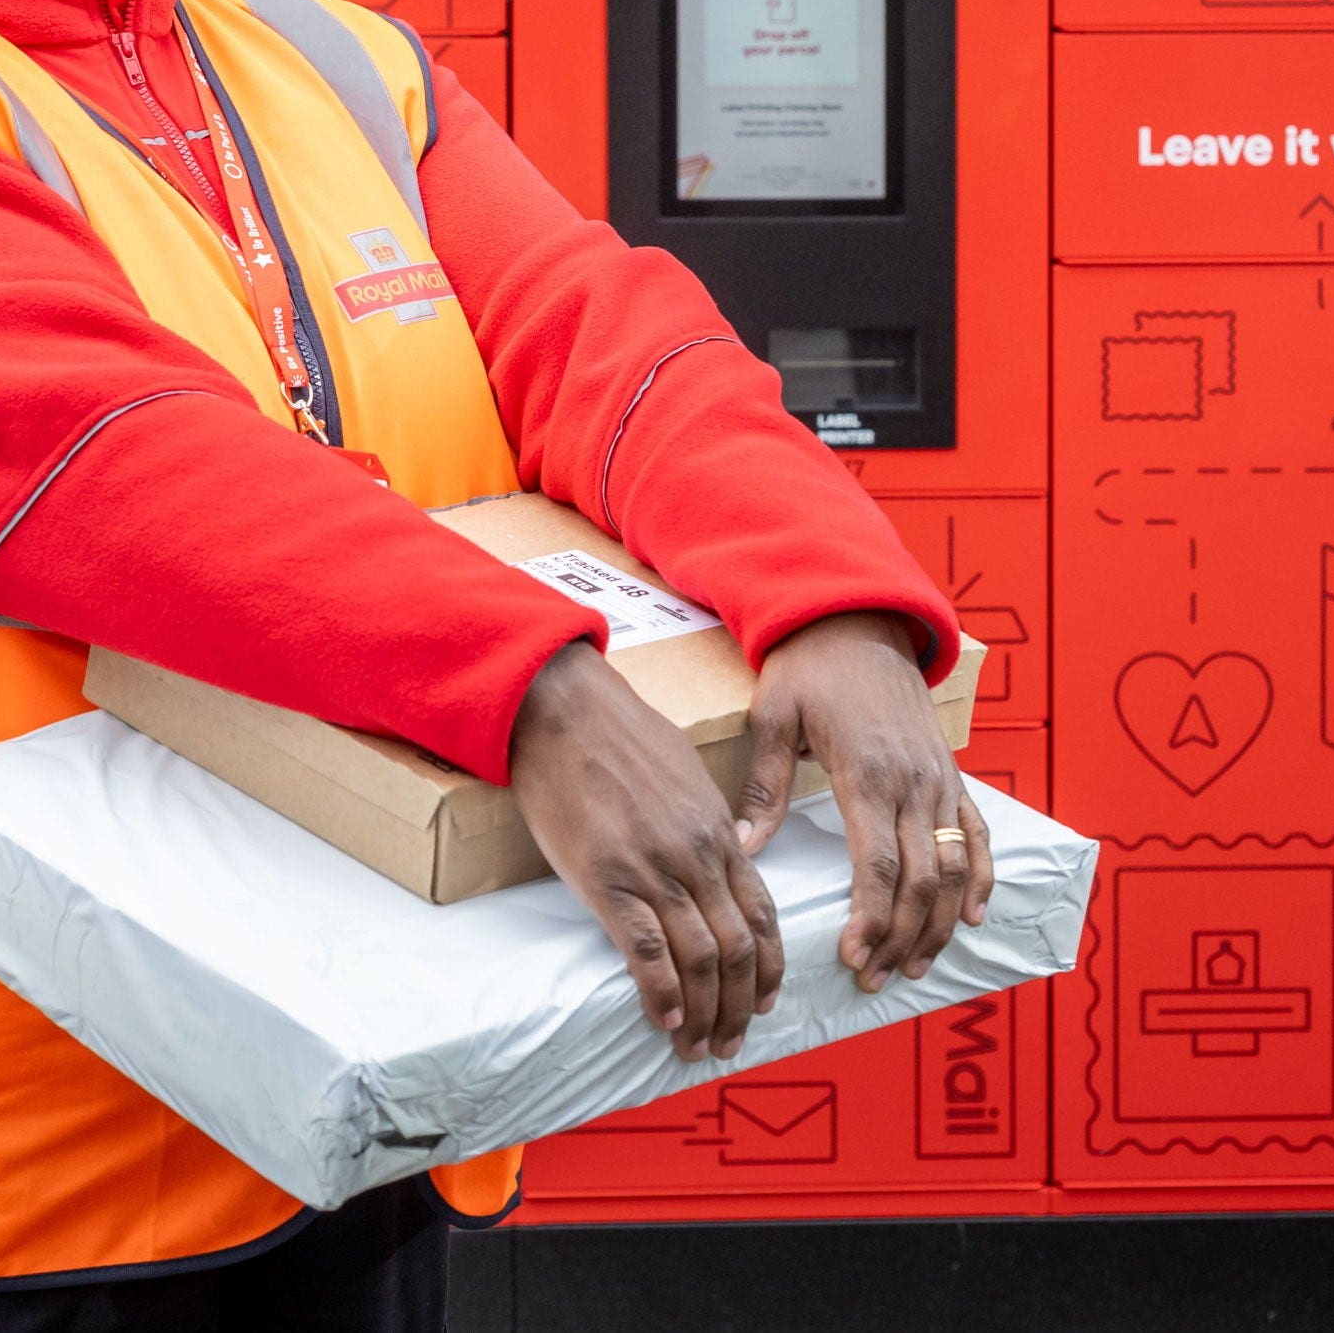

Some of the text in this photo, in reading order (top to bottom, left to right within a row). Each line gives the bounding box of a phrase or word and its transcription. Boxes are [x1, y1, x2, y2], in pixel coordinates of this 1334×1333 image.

[1138, 125, 1273, 167] Leave
[1284, 124, 1320, 166] it
[240, 206, 261, 237] Brilliant
[252, 239, 265, 250] Be
[346, 267, 450, 307] Royal Mail
[285, 355, 299, 370] Be
[562, 553, 622, 583] Tracked
[616, 584, 650, 598] 48
[944, 997, 999, 1136] Mail
